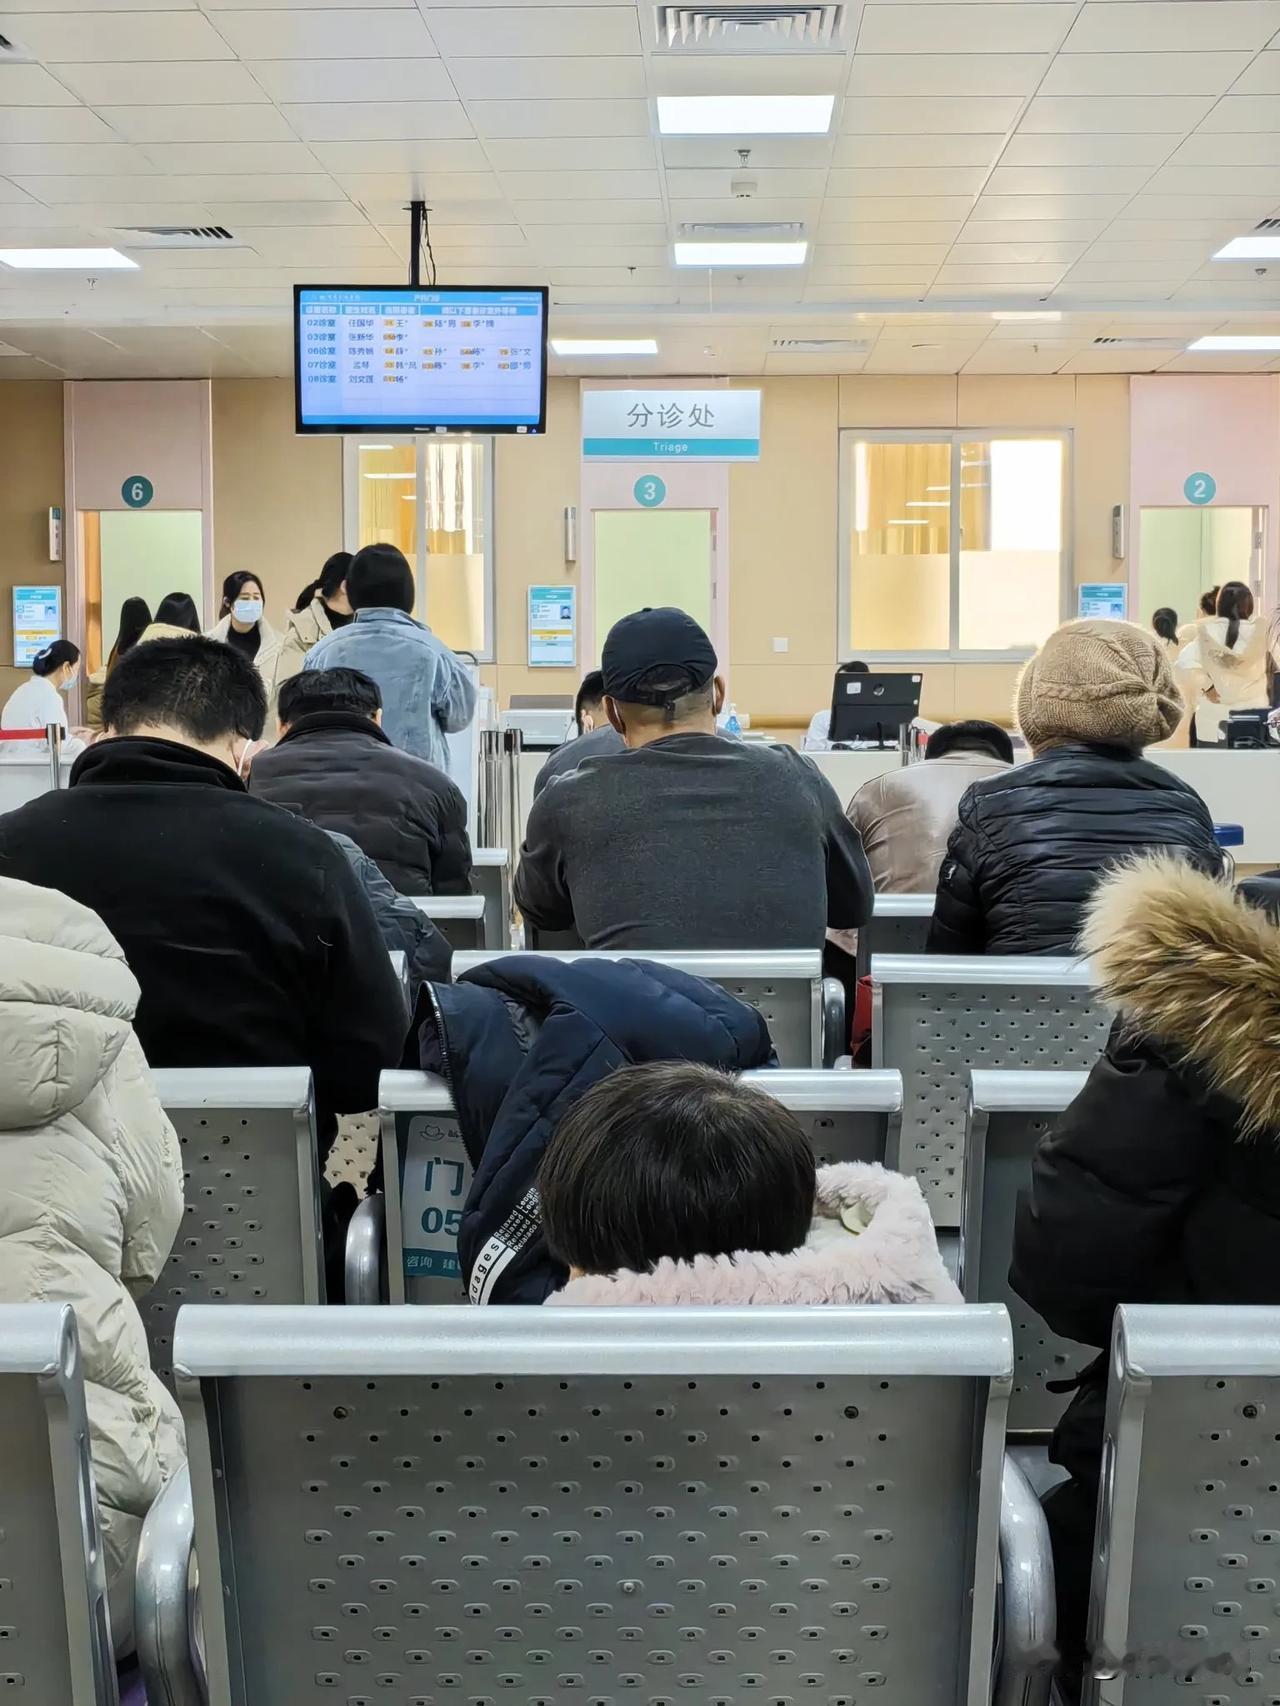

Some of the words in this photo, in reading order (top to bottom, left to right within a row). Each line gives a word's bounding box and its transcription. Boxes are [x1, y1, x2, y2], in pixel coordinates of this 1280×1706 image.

[627, 402, 715, 429] 分诊处
[652, 441, 689, 454] Triage
[131, 483, 144, 501] 6
[643, 482, 657, 501] 3
[1194, 480, 1207, 498] 2
